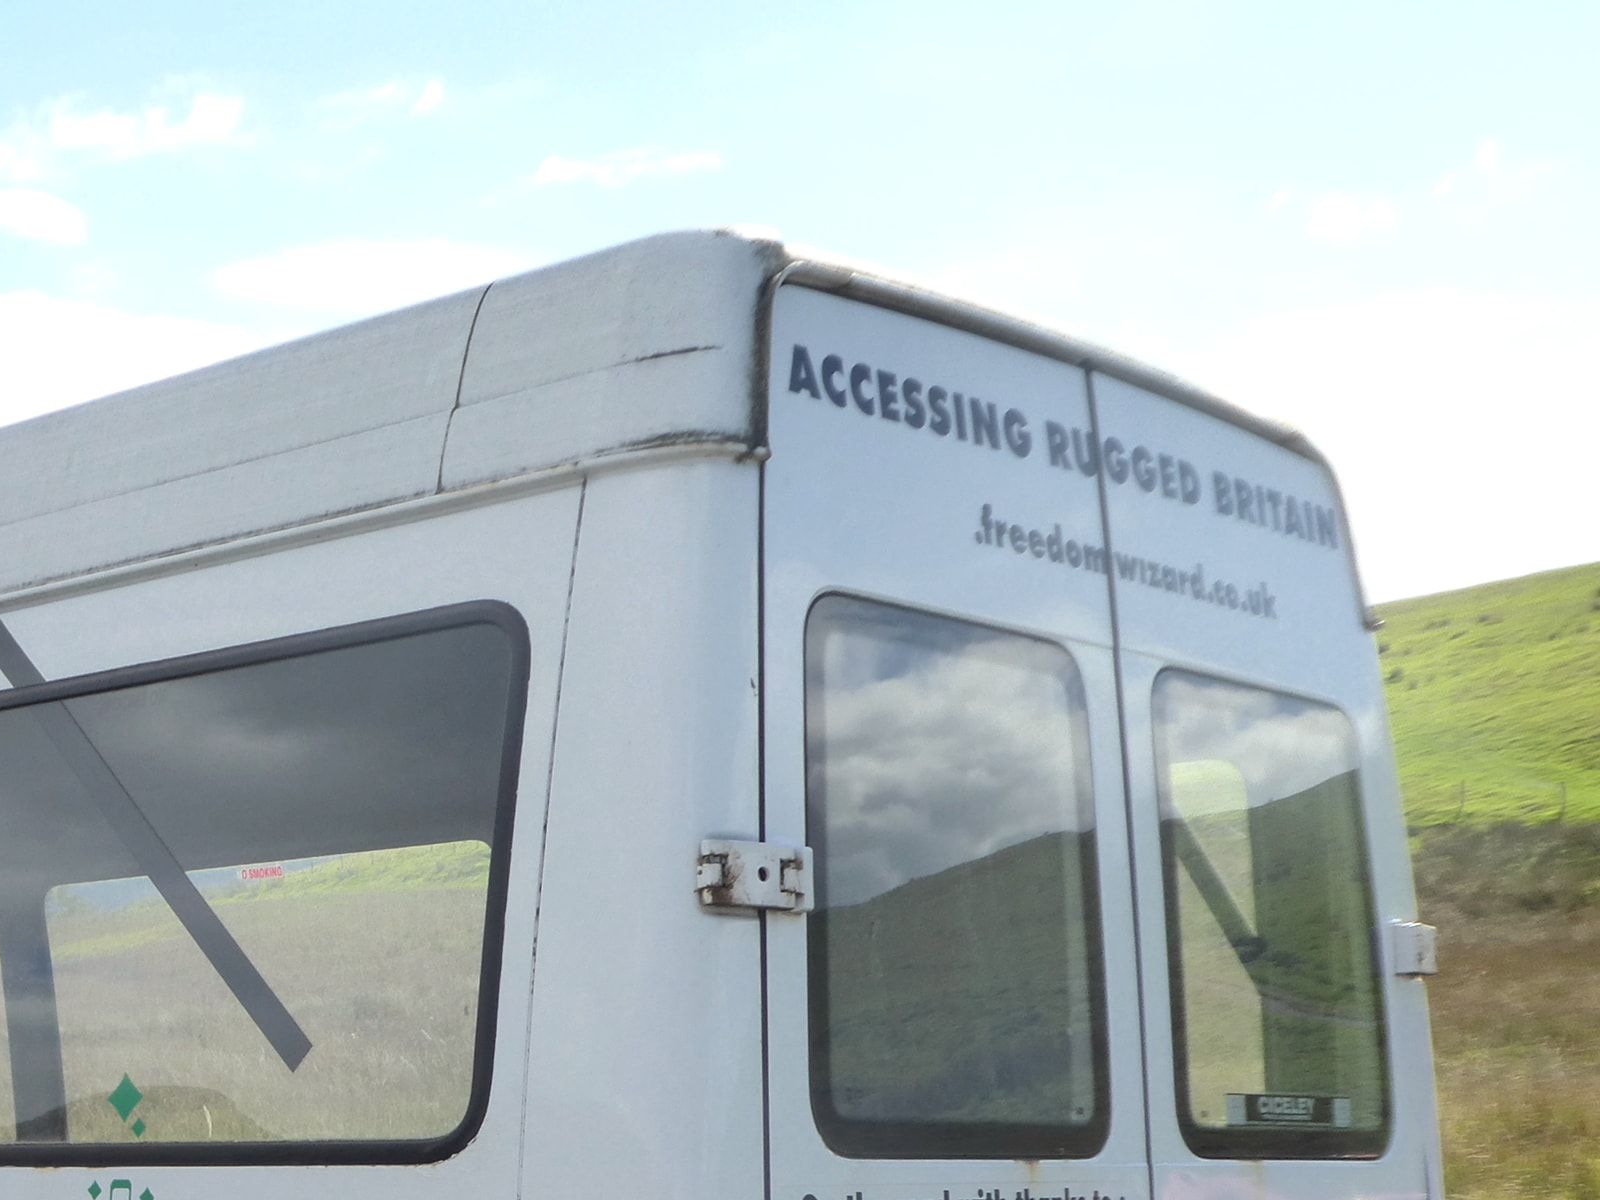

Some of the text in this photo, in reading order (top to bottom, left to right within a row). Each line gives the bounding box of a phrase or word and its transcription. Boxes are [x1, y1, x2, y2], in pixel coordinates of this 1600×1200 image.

[788, 343, 1340, 550] ACCESSING RUGGED BRITAIN
